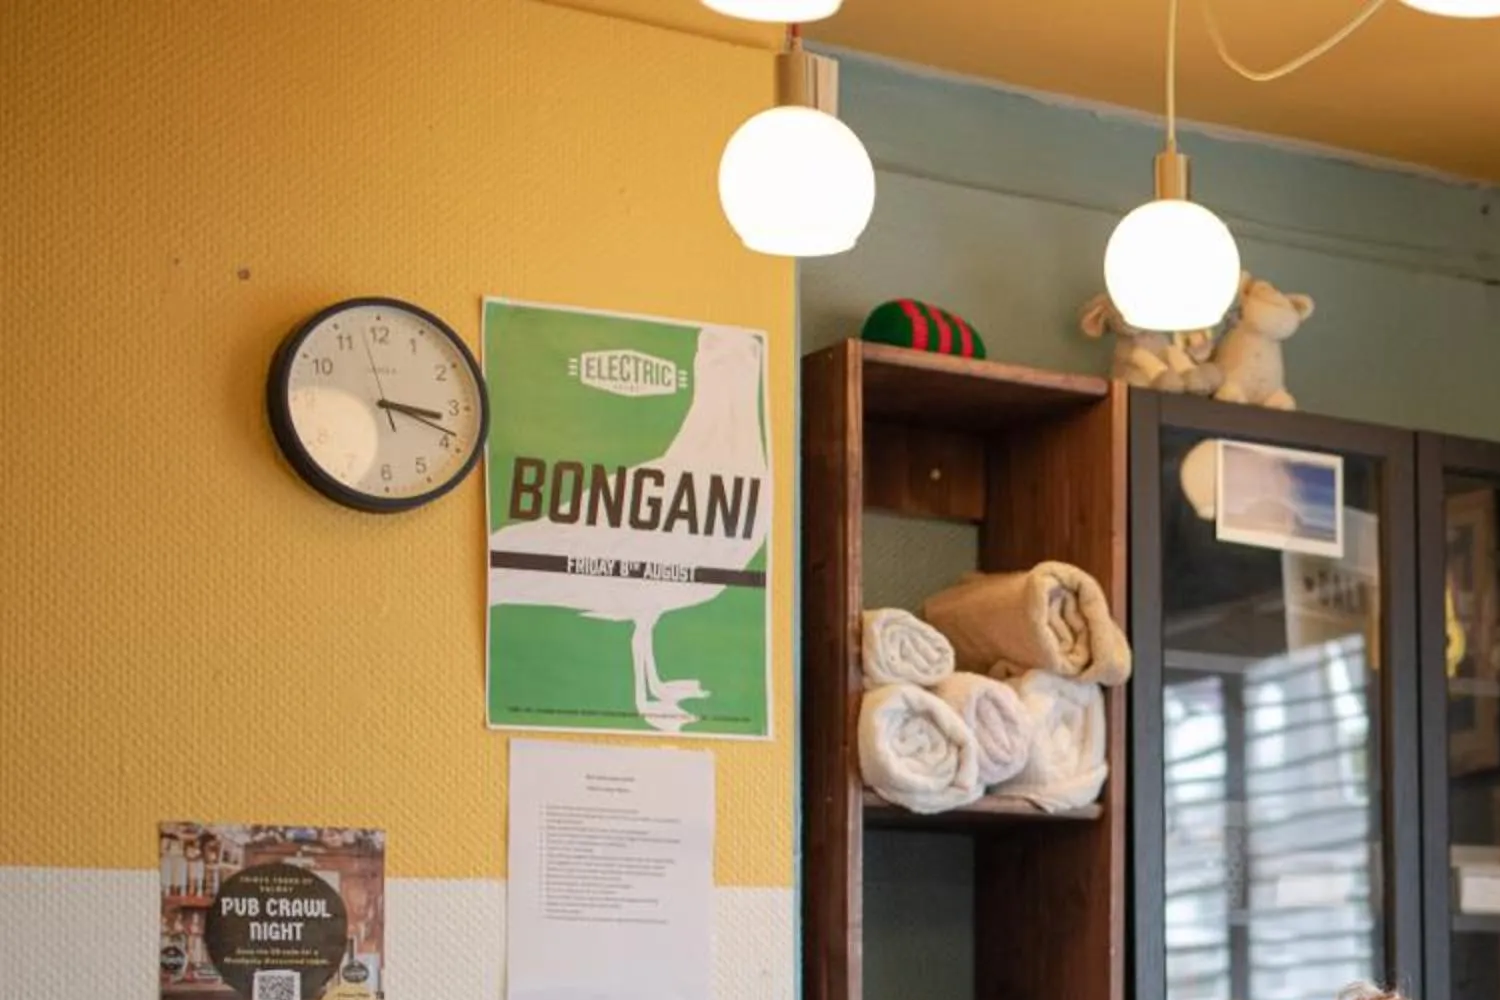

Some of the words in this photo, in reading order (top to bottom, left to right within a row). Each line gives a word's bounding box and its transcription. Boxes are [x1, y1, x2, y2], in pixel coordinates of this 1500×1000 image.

[337, 335, 354, 351] 11
[370, 326, 390, 345] 12
[409, 338, 418, 355] 1
[313, 358, 334, 376] 10
[434, 365, 447, 382] 2
[585, 354, 672, 388] ELECTRIC
[448, 400, 460, 417] 3
[438, 435, 450, 450] 4
[380, 464, 392, 481] 6
[415, 456, 427, 474] 5
[508, 456, 761, 540] BONGANI
[567, 555, 615, 576] FRIDAY
[642, 559, 696, 582] AUGUST
[220, 897, 260, 916] PUB
[265, 897, 333, 918] CRAWL
[249, 921, 305, 941] NIGHT
